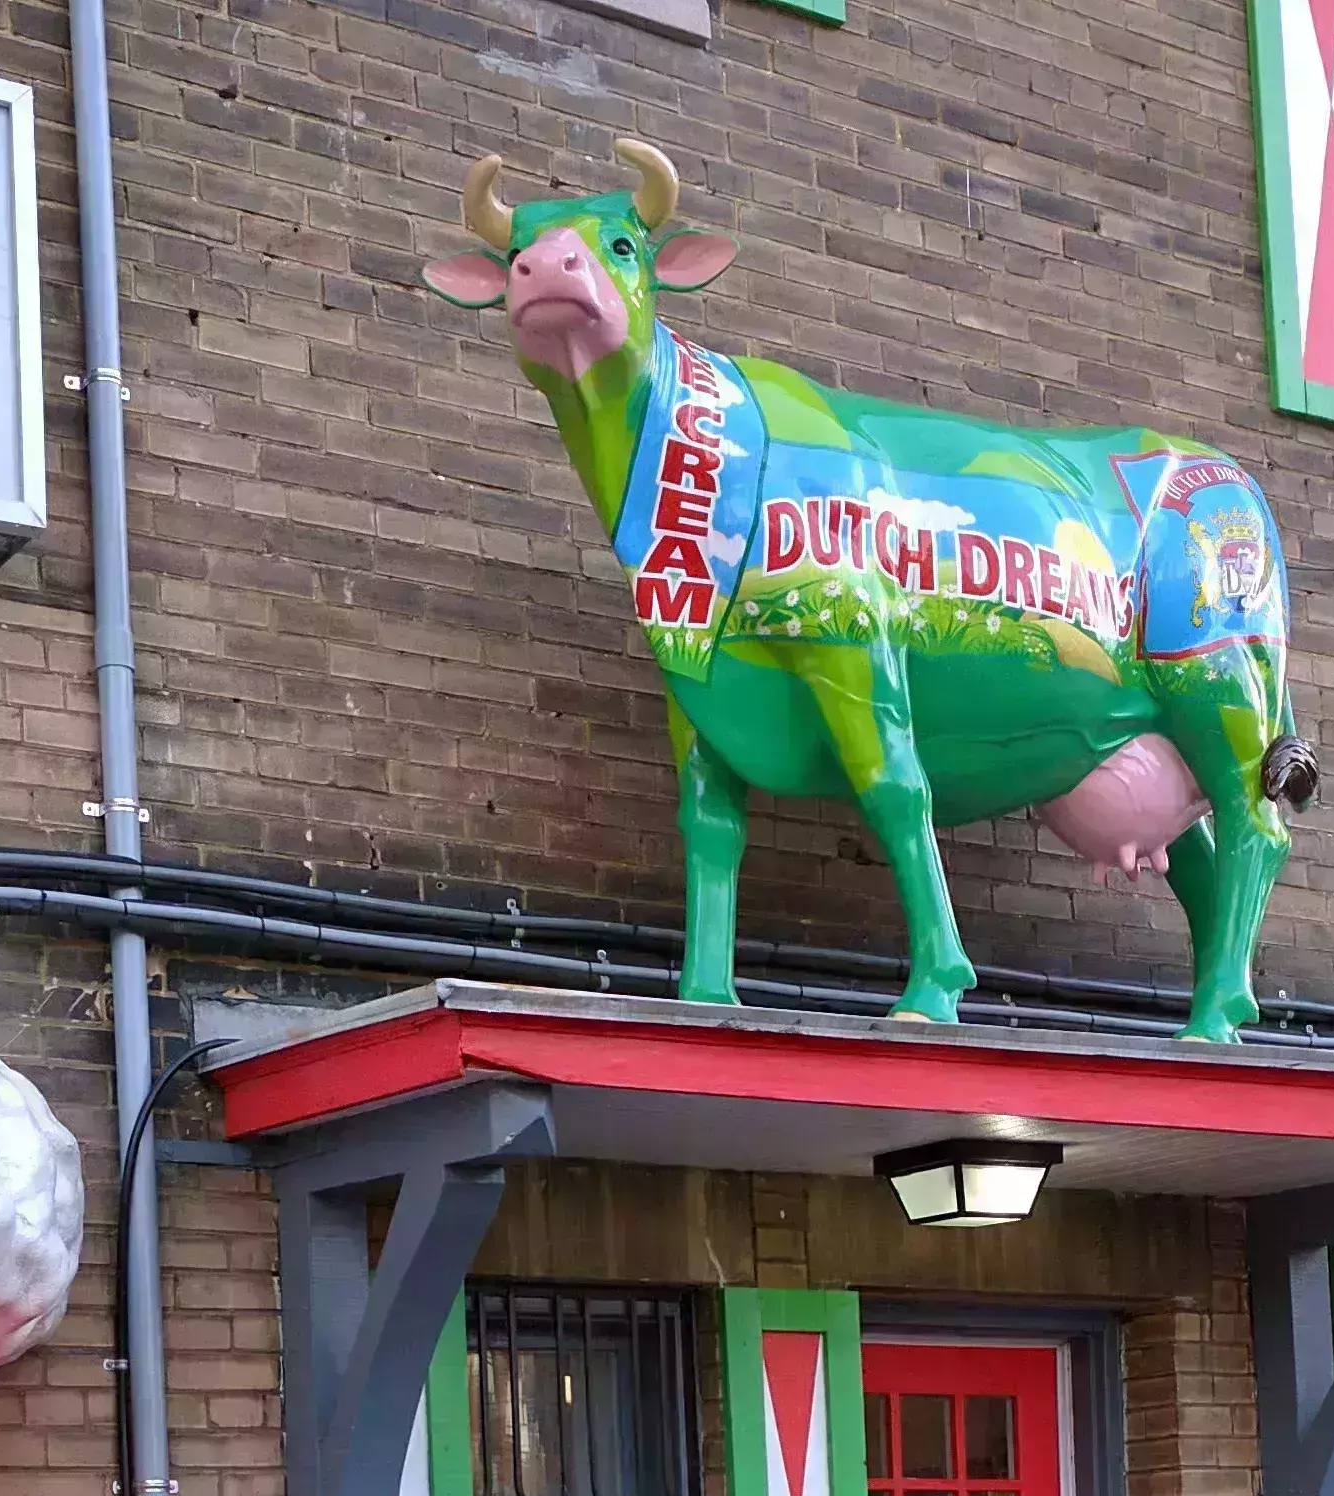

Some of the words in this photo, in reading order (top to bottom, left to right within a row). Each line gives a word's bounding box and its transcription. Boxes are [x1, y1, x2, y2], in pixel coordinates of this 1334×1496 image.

[635, 403, 722, 625] CREAM
[764, 497, 939, 594] DUTCH
[957, 530, 1135, 641] DREAMS
